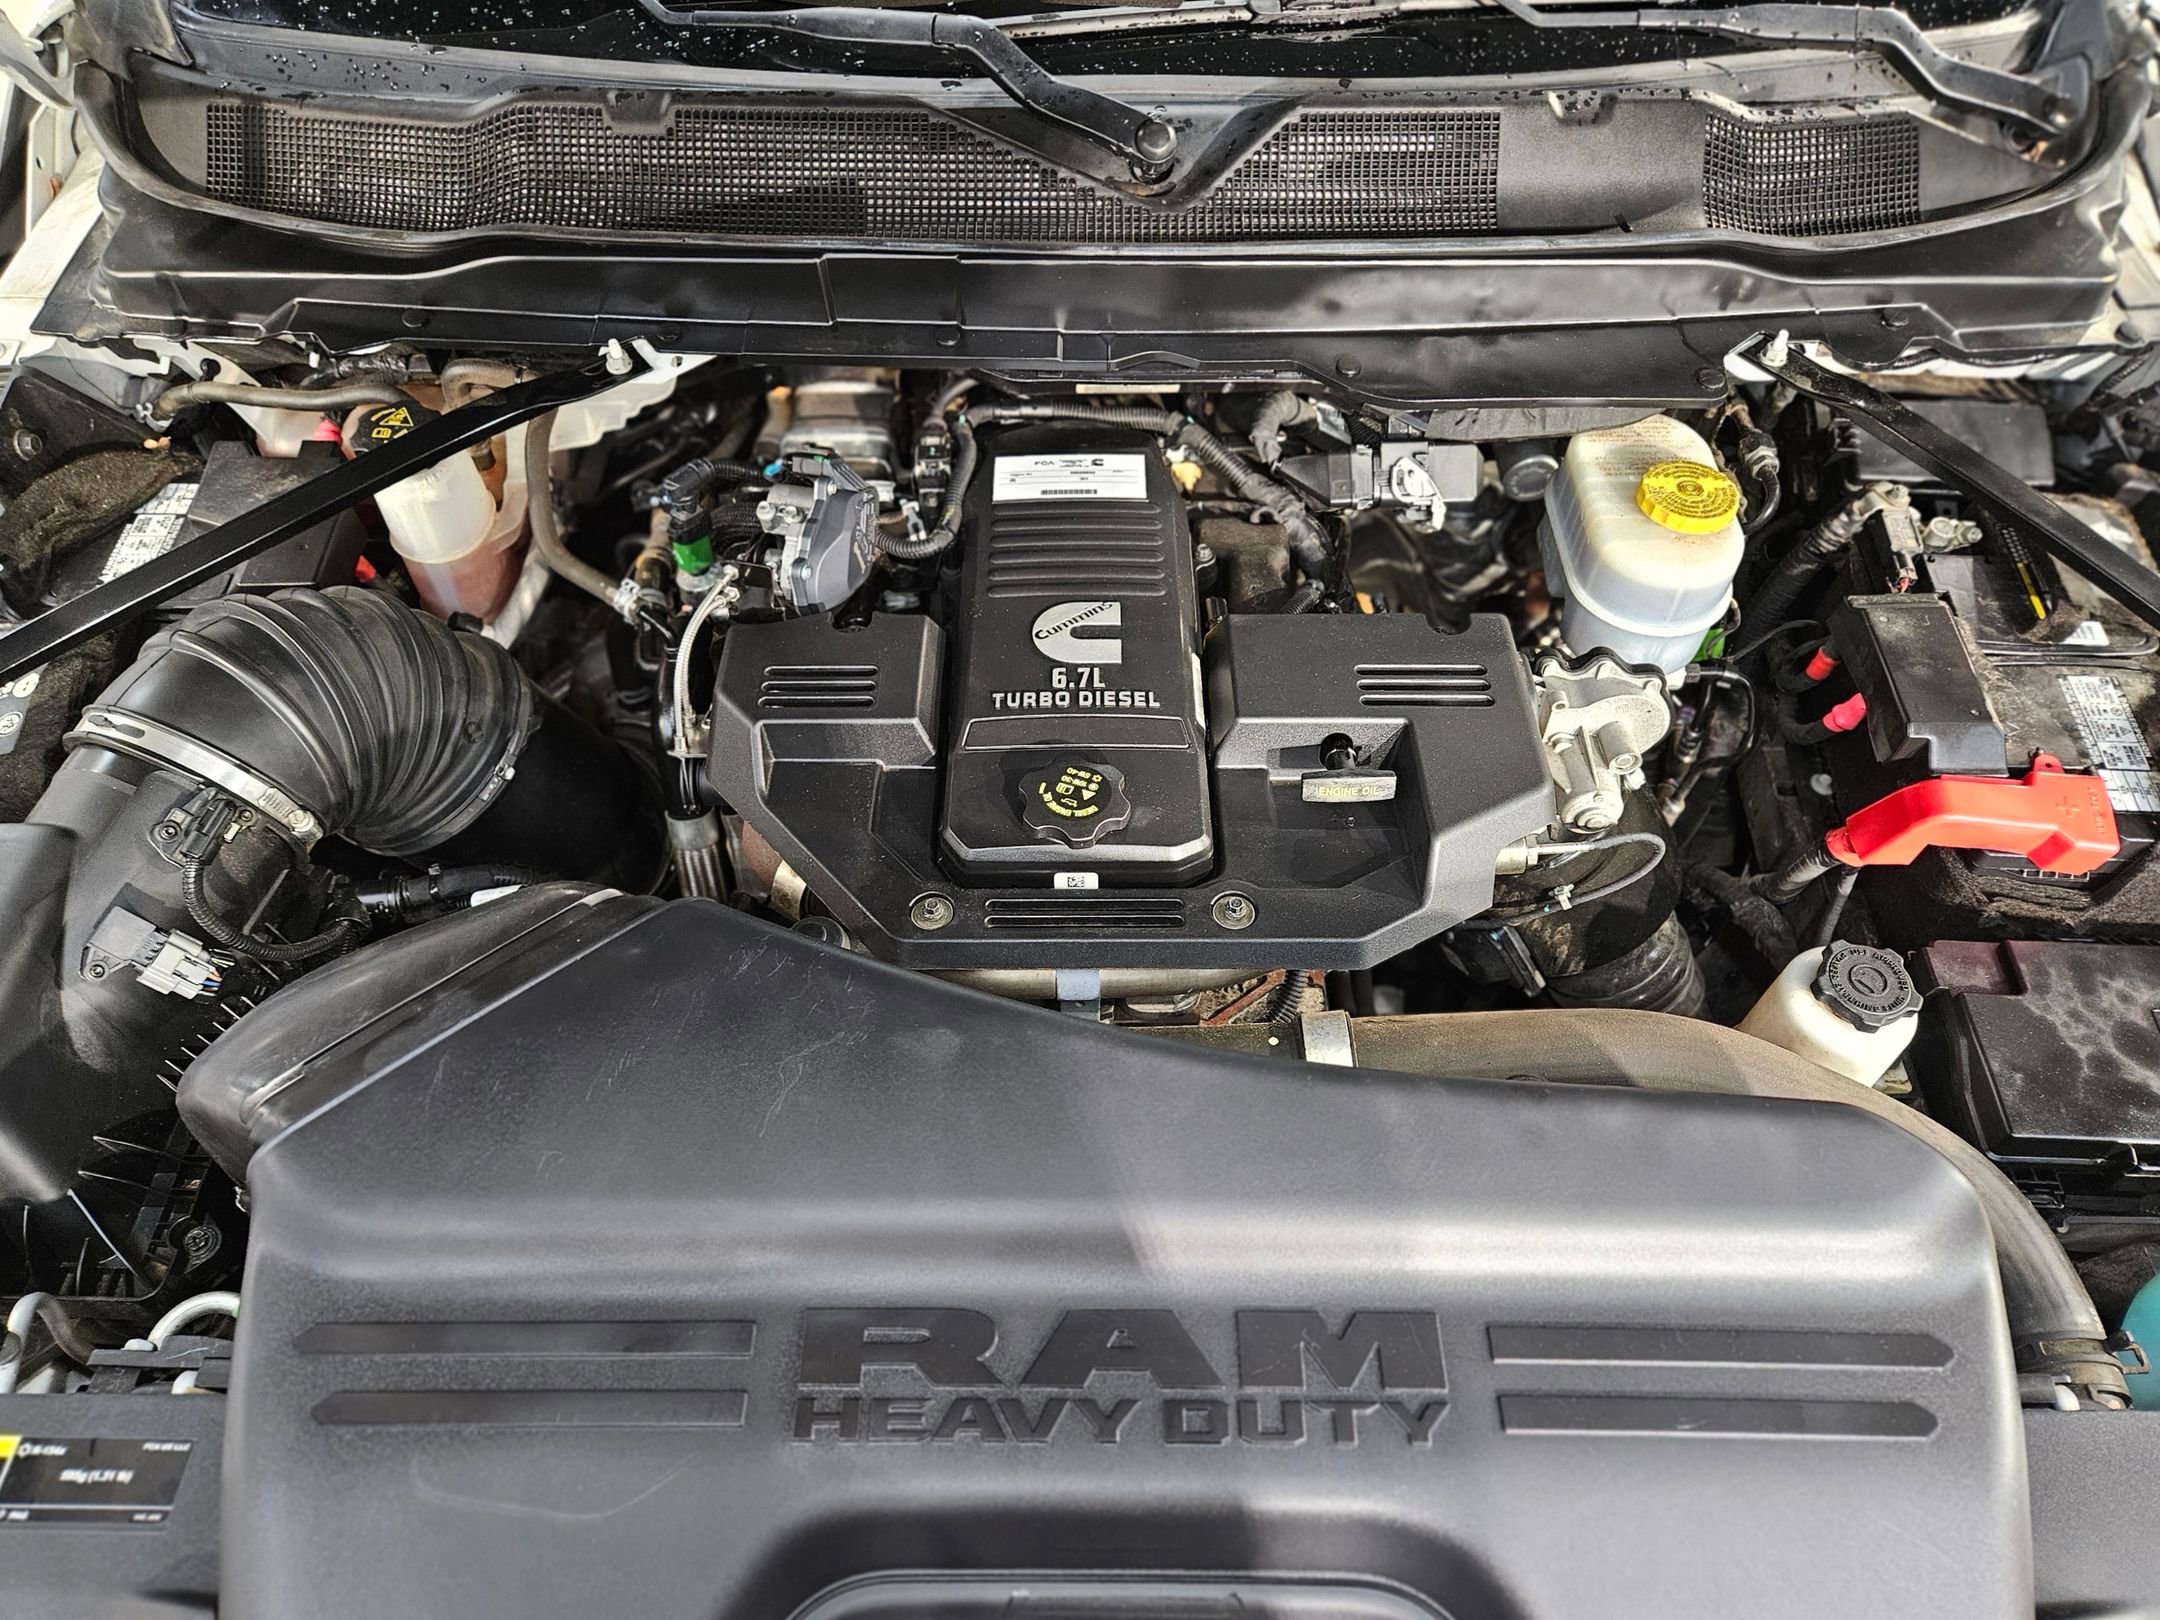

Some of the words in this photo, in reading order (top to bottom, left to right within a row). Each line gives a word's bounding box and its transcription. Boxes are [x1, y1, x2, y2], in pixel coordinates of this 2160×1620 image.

[1034, 602, 1113, 640] Cummins
[1052, 667, 1106, 689] 6.7L
[992, 691, 1071, 709] TURBO
[1078, 690, 1161, 708] DIESEL
[1319, 786, 1358, 796] ENGINE
[1361, 786, 1379, 795] OIL
[799, 1307, 1450, 1392] RAM
[792, 1398, 1142, 1446] HEAVY
[1161, 1398, 1452, 1447] DUTY
